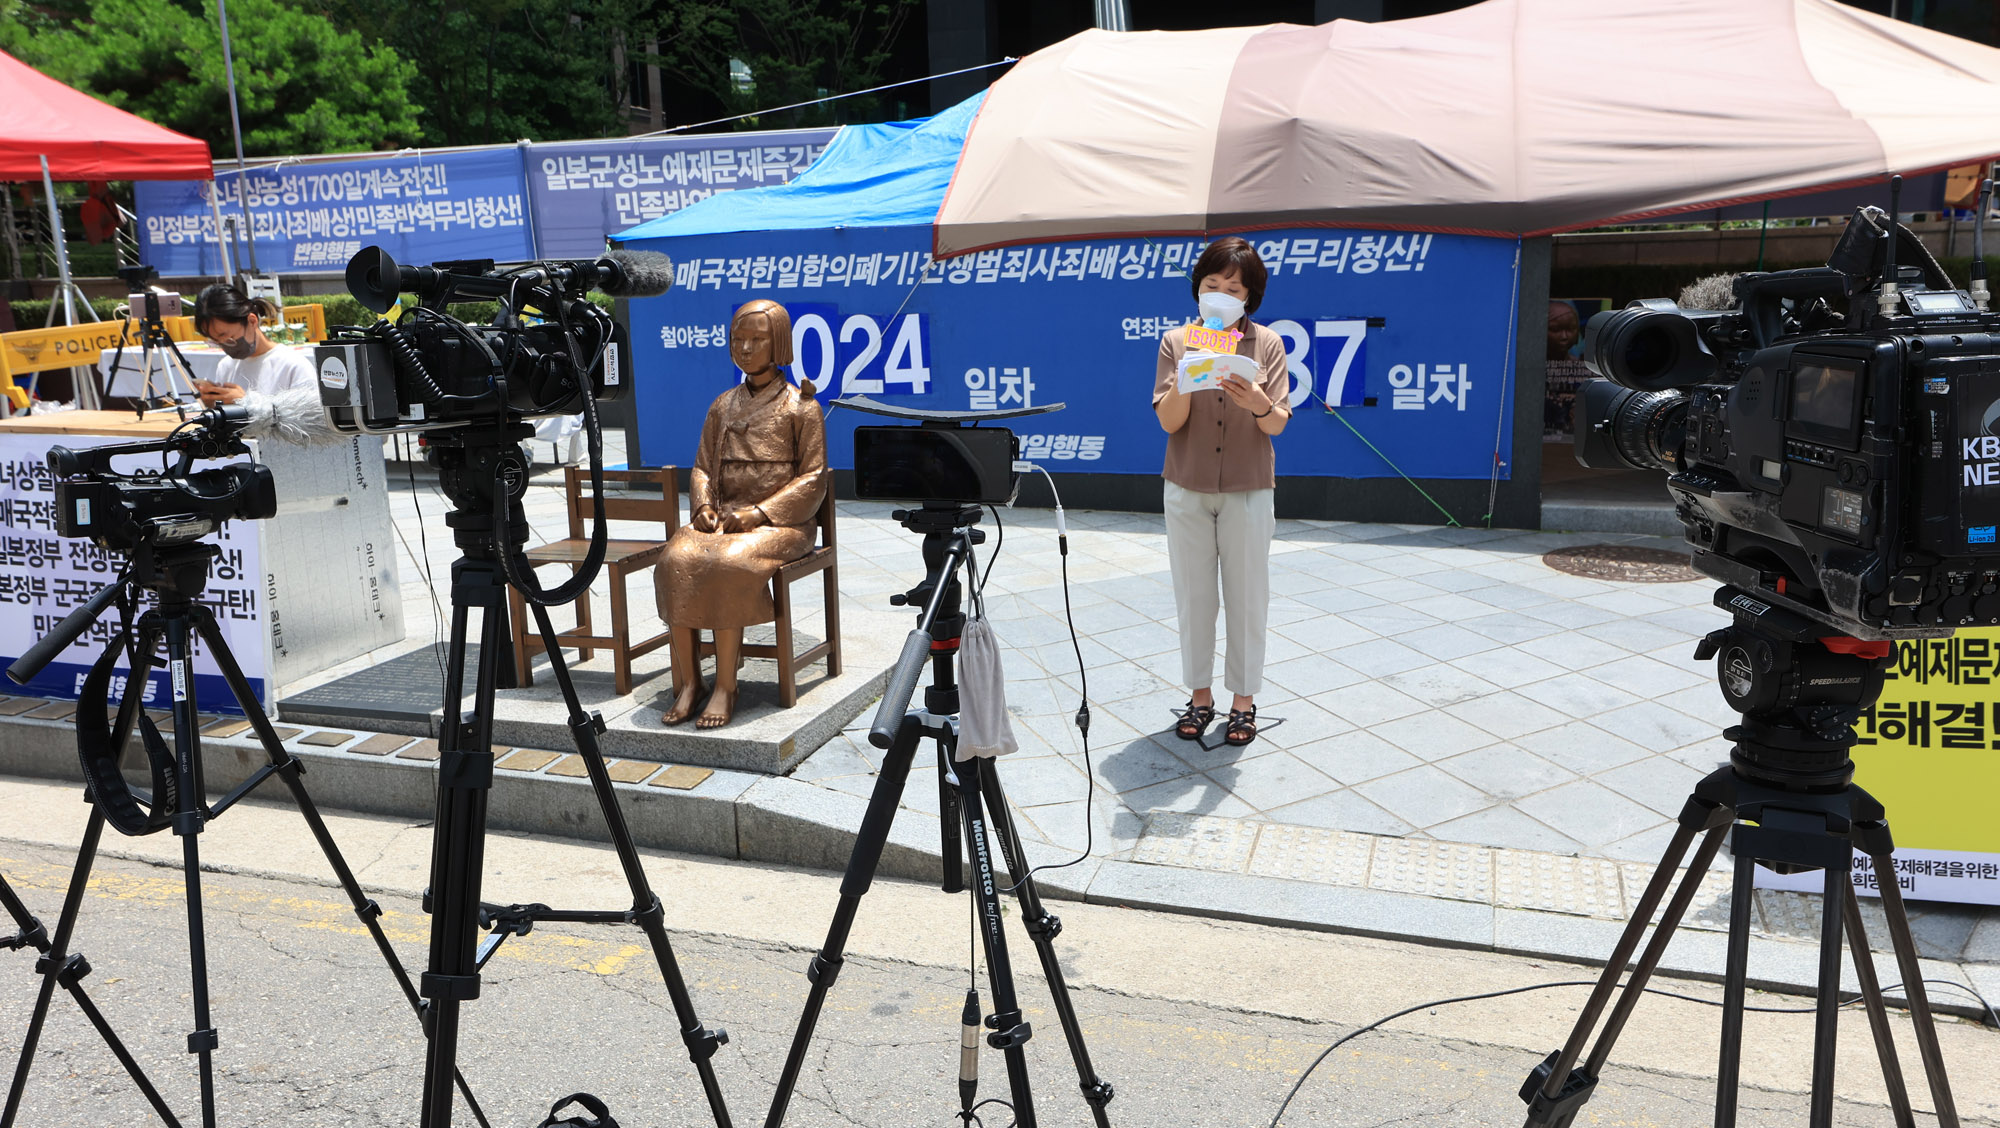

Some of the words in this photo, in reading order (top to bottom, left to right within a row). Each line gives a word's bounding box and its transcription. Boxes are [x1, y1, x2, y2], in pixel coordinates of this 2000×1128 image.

[542, 144, 827, 191] 일본군성노예제문제즉각
[54, 334, 119, 356] POLICE
[660, 324, 727, 349] 철야농성
[741, 313, 931, 395] 024
[1187, 328, 1236, 353] 1500차
[964, 366, 1036, 411] 일차
[1388, 363, 1473, 411] 일차
[996, 827, 1014, 870] Manfrotto
[972, 819, 994, 896] Manfrotto
[987, 902, 999, 934] befree
[1852, 873, 1915, 892] 희망비
